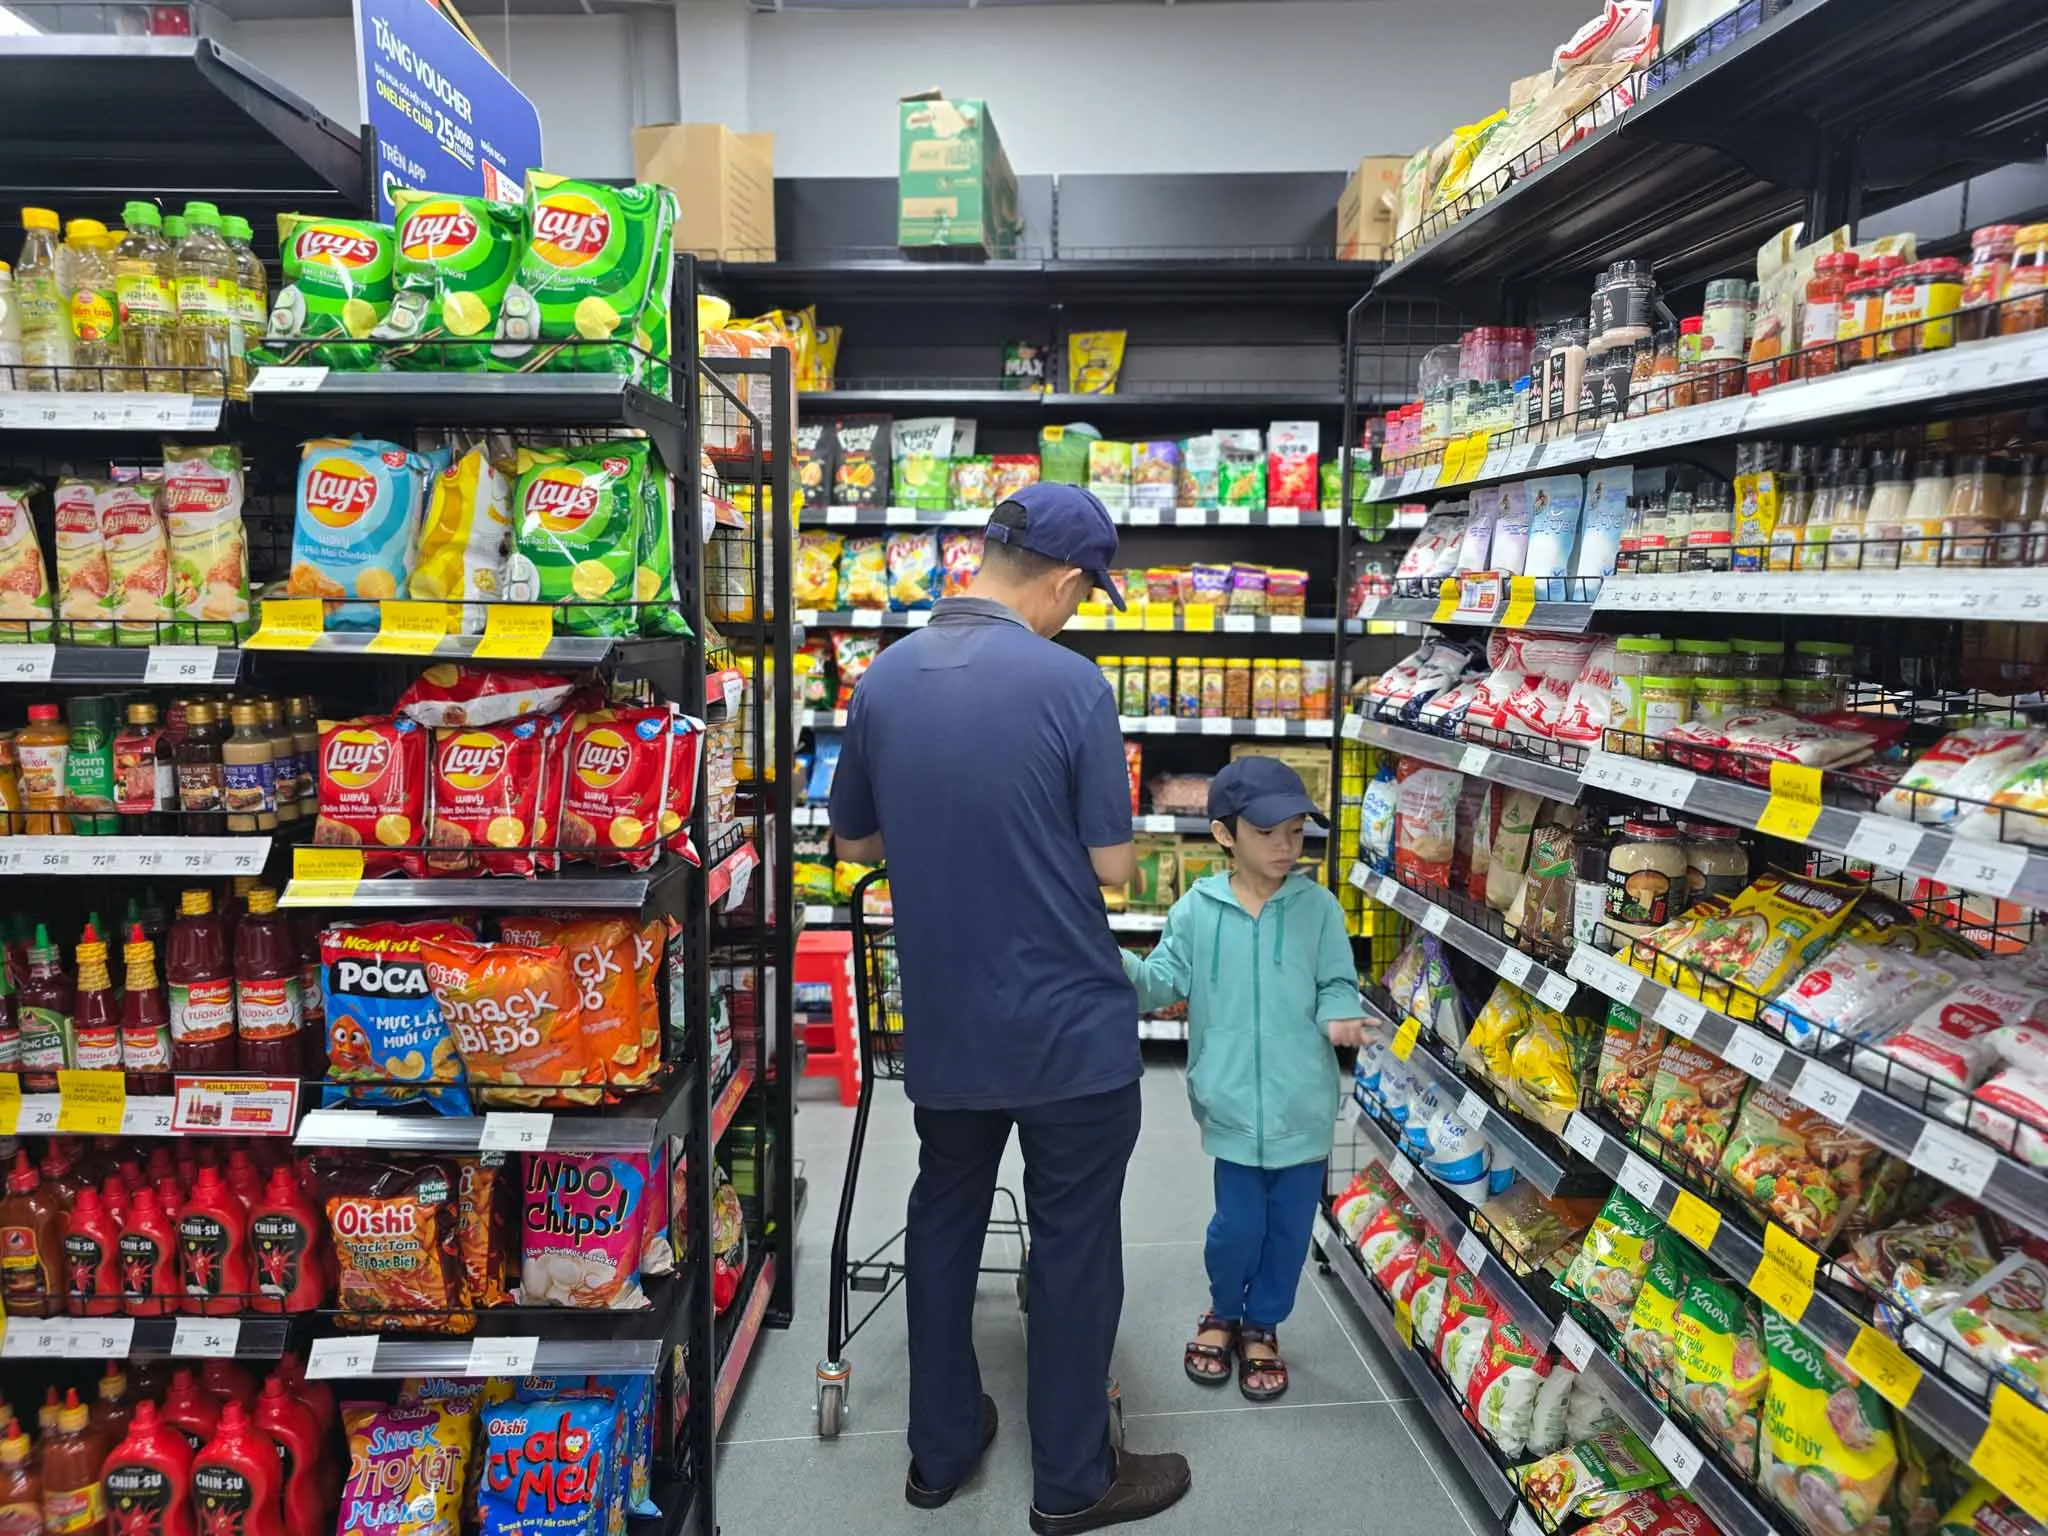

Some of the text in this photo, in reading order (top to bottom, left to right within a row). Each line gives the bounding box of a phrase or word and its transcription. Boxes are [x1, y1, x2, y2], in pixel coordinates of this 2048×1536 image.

[371, 16, 473, 124] TẶNG VOUCHER
[376, 79, 434, 134] ONELIFE CLUB
[380, 139, 427, 183] TRÊN APP
[404, 213, 475, 251] Lay's
[533, 206, 608, 251] Lay's
[299, 231, 377, 260] Lay's
[1005, 359, 1044, 377] MAX
[308, 470, 375, 513] Lay's
[527, 479, 598, 517] Lay's
[16, 663, 35, 673] 40
[179, 664, 198, 675] 58
[68, 755, 105, 767] Ssam
[328, 741, 387, 775] Lay's
[444, 745, 502, 778] Lay's
[578, 741, 629, 776] Lay's
[69, 766, 105, 779] Jang
[340, 793, 369, 805] wavy
[455, 795, 485, 807] wavy
[1887, 843, 1897, 855] 9
[43, 854, 60, 866] 56
[185, 854, 201, 867] 75
[235, 854, 251, 867] 75
[1977, 865, 1998, 881] 33
[503, 928, 540, 947] Oishi
[338, 961, 429, 994] POCA
[427, 961, 470, 994] Oishi
[276, 1006, 290, 1016] CÀ
[434, 987, 560, 1025] Snack
[1676, 1014, 1688, 1026] 53
[43, 1036, 61, 1047] CÀ
[383, 1028, 418, 1049] MUỐI
[457, 1017, 540, 1055] Bí Đỏ
[1751, 1052, 1764, 1066] 10
[1751, 1090, 1793, 1122] ORGANIC
[1823, 1091, 1838, 1106] 20
[36, 1113, 171, 1127] 20 32
[520, 1132, 533, 1142] 13
[1581, 1134, 1592, 1147] 22
[1947, 1158, 1967, 1175] 34
[526, 1155, 616, 1200] INDO
[418, 1180, 449, 1194] KHÔNG
[1637, 1181, 1649, 1193] 46
[418, 1191, 448, 1203] CHIÊN
[336, 1202, 417, 1237] Oishi
[526, 1188, 630, 1248] Chips!
[1608, 1200, 1648, 1236] Knorr
[180, 1223, 220, 1235] CHIN-SU
[255, 1222, 296, 1235] CHIN-SU
[64, 1240, 96, 1250] CHIN-SU
[120, 1239, 152, 1250] CHIN-SU
[344, 1241, 382, 1254] Snack
[1690, 1285, 1732, 1330] Knorr
[38, 1336, 114, 1348] 18 19
[204, 1336, 221, 1347] 34
[1572, 1341, 1584, 1356] 18
[1762, 1312, 1825, 1381] Knorr
[346, 1356, 359, 1367] 13
[506, 1355, 519, 1366] 13
[1878, 1367, 1898, 1387] 20
[487, 1417, 530, 1437] Oishi
[1672, 1452, 1687, 1469] 38
[107, 1473, 163, 1488] CHIN-SU
[195, 1473, 244, 1490] CHIN-SU
